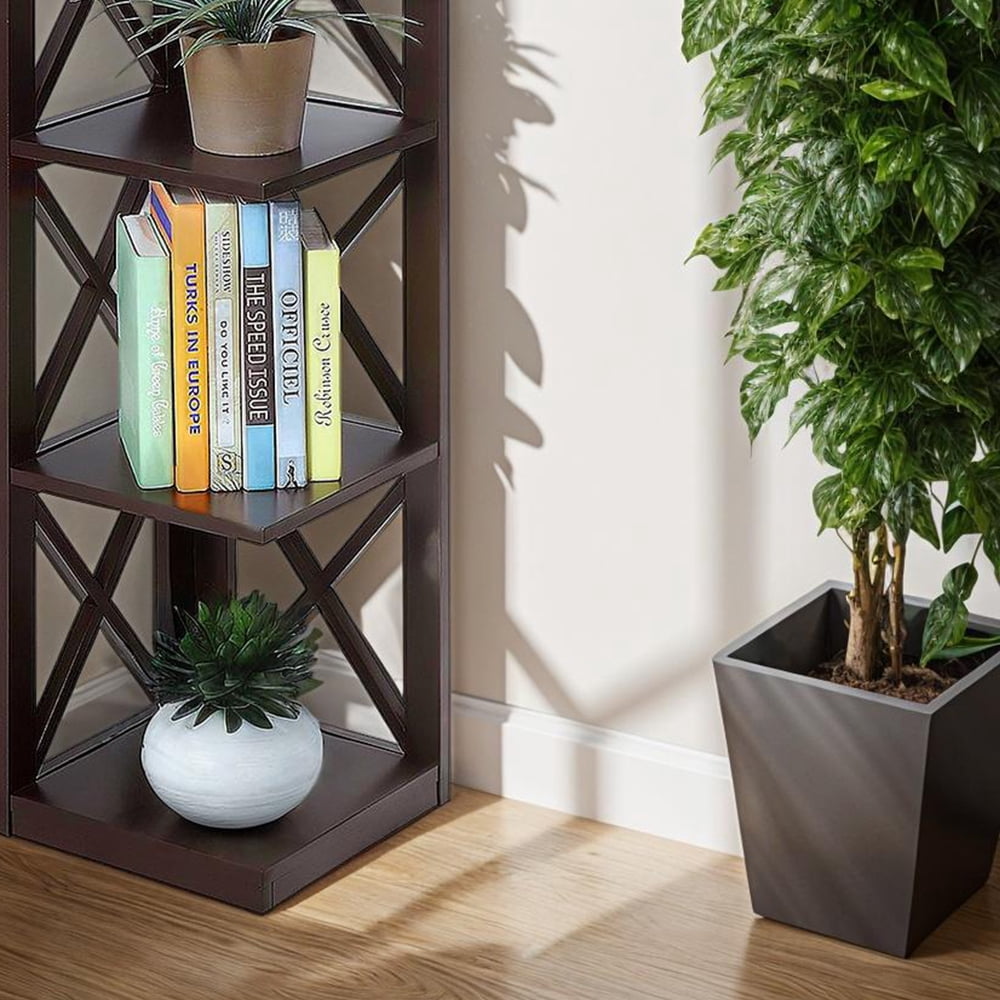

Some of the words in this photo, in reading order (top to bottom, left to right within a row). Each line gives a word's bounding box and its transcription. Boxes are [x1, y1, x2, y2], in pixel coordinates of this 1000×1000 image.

[221, 230, 232, 293] SIDESHOW
[185, 263, 199, 324] TURKS
[246, 272, 265, 307] THE
[187, 331, 199, 352] IN
[220, 320, 228, 338] DO
[246, 311, 267, 365] SPEED
[280, 291, 300, 406] OFFICIEL
[312, 301, 332, 352] Crusoe
[220, 343, 229, 368] YOU
[188, 360, 201, 435] EUROPE
[221, 371, 229, 398] LIKE
[248, 368, 269, 421] ISSUE
[313, 357, 333, 427] Robinson
